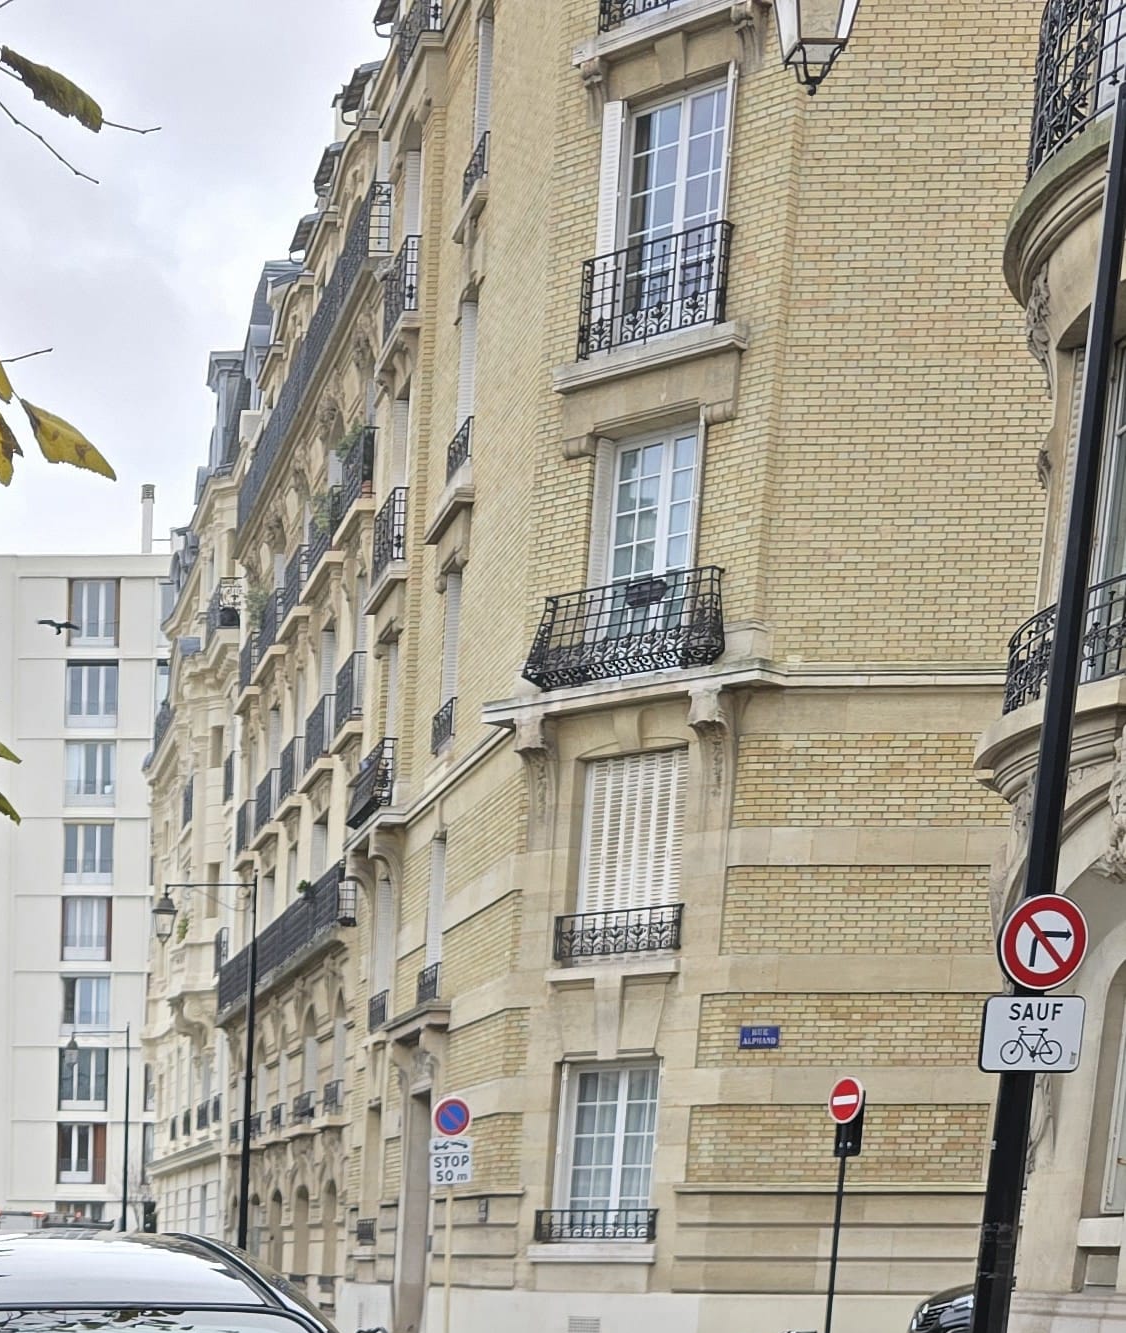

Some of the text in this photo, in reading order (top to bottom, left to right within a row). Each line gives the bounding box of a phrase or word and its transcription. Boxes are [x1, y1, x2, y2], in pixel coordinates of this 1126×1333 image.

[1009, 1003, 1063, 1021] SAUF
[751, 1028, 769, 1036] RUE
[434, 1155, 469, 1168] STOP
[436, 1170, 453, 1182] 50
